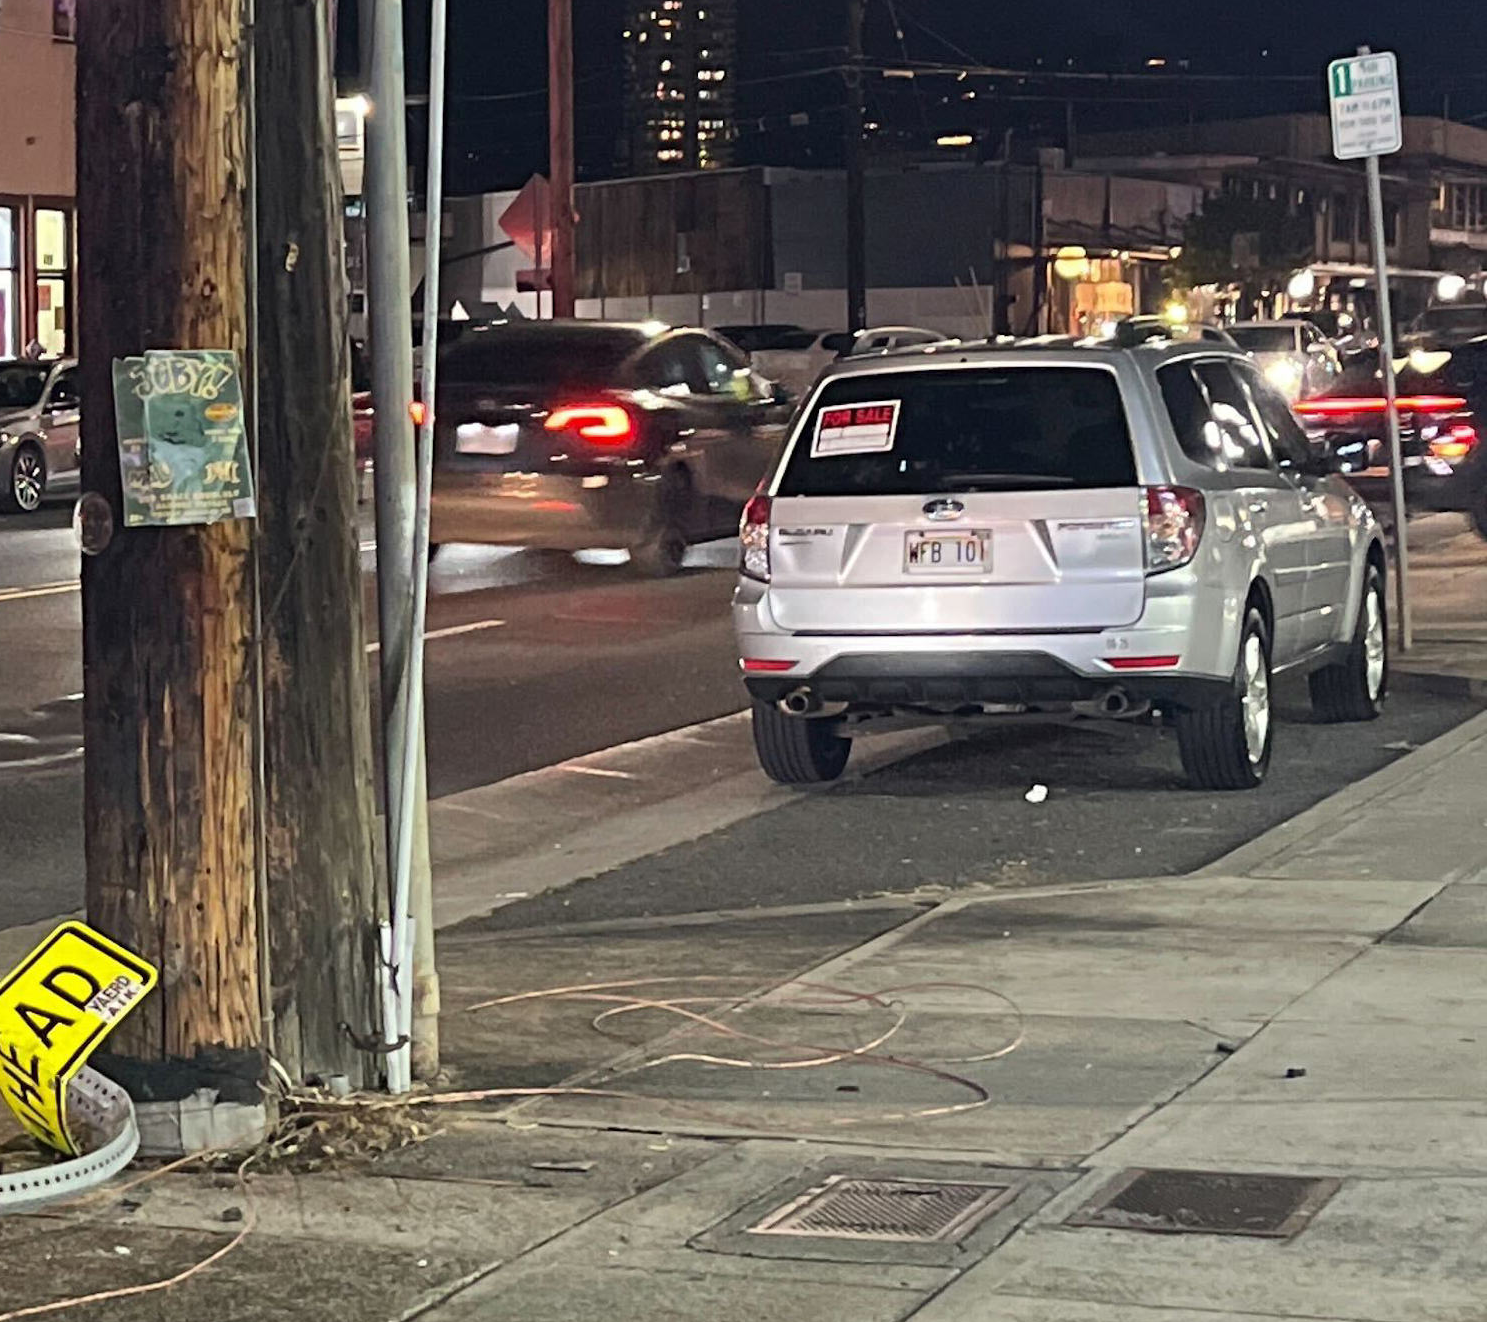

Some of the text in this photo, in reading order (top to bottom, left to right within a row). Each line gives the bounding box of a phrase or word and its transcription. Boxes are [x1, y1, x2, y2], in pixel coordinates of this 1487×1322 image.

[1336, 64, 1347, 95] 1
[823, 406, 892, 427] FOR SALE
[909, 540, 986, 564] WFB 101
